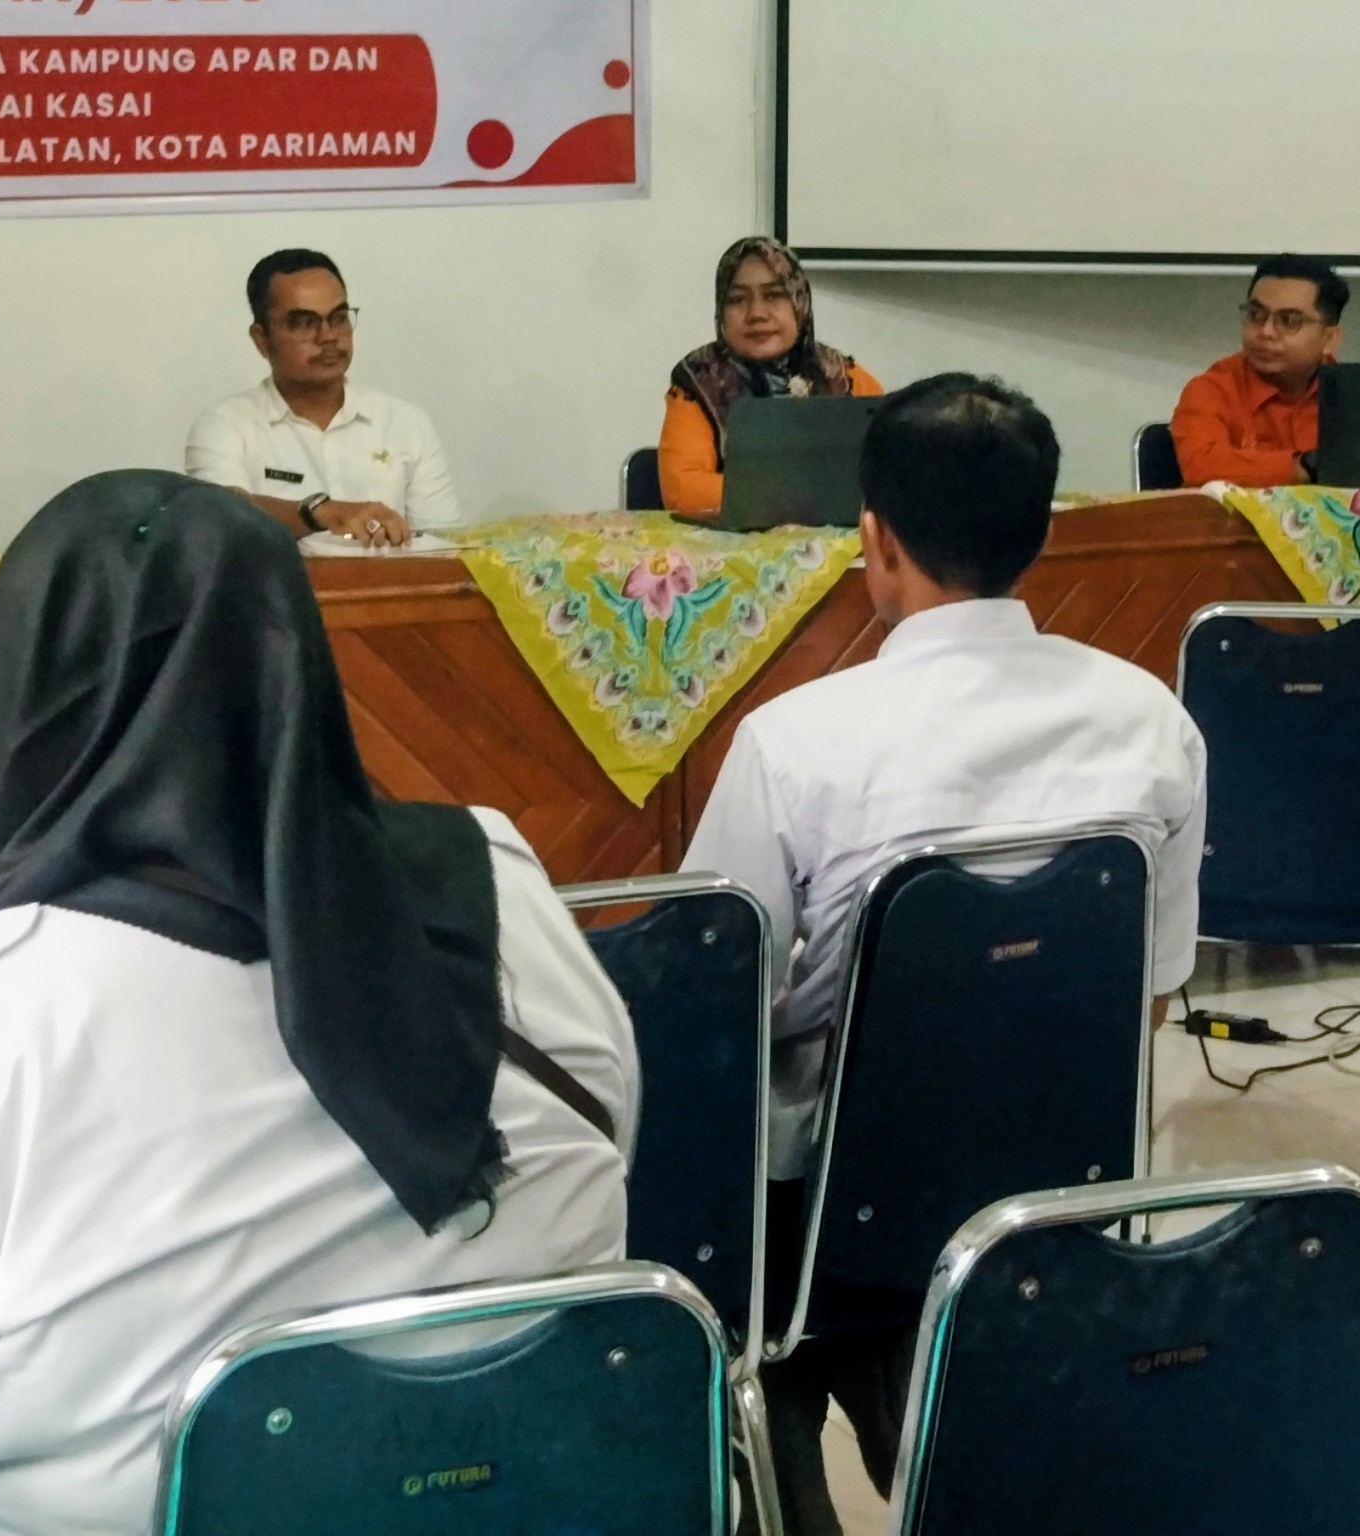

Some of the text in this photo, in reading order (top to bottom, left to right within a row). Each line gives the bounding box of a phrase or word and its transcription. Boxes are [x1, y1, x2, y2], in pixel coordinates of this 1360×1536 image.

[18, 47, 197, 75] KAMPUNG
[207, 47, 297, 72] APAR
[308, 46, 379, 72] DAN
[46, 91, 153, 118] KASAI
[134, 133, 229, 161] KOTA
[240, 130, 417, 158] PARIAMAN
